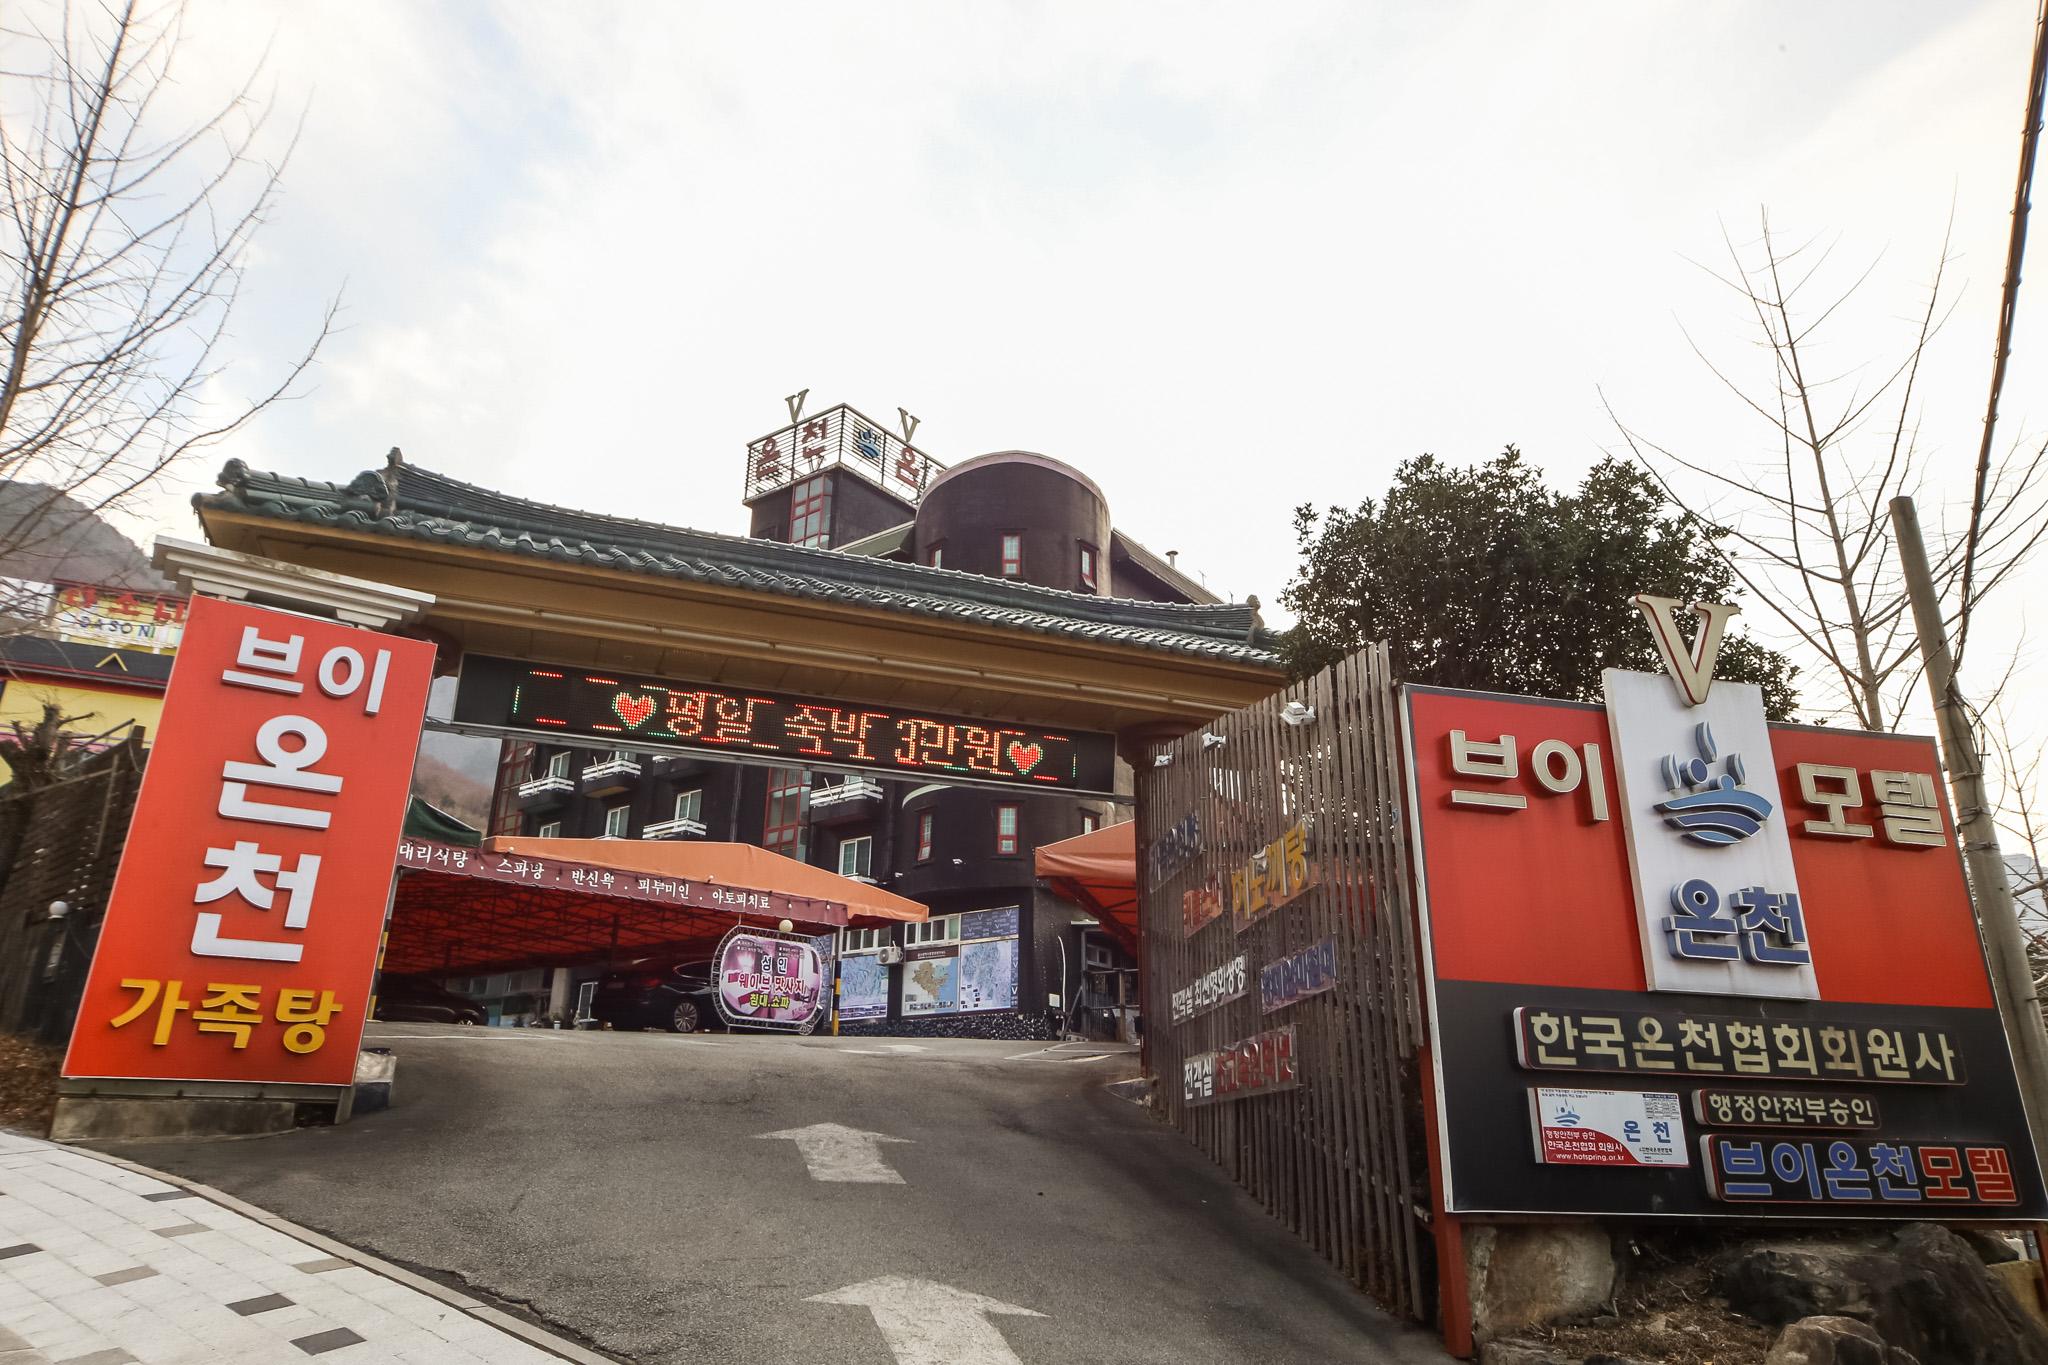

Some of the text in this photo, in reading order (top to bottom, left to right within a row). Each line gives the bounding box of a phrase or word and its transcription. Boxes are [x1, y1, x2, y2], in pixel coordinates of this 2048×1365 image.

[785, 388, 810, 424] V
[897, 407, 921, 443] V
[222, 626, 392, 716] 브이
[1630, 593, 1741, 707] V
[666, 692, 1001, 774] 평일 숙박 3만원
[1447, 729, 1609, 823] 브이
[1791, 761, 1947, 848] 모텔
[637, 877, 689, 900] 피부미인
[712, 888, 771, 910] 아토피치료
[1662, 877, 1810, 966] 온천
[110, 977, 343, 1055] 가족탕
[739, 973, 805, 995] 웨이브 맛사지
[1530, 1011, 1956, 1081] 한국온천협회회원사
[1709, 1093, 1875, 1126] 행정안전부승인
[1556, 1153, 1625, 1162] www.hotspring.or.kr
